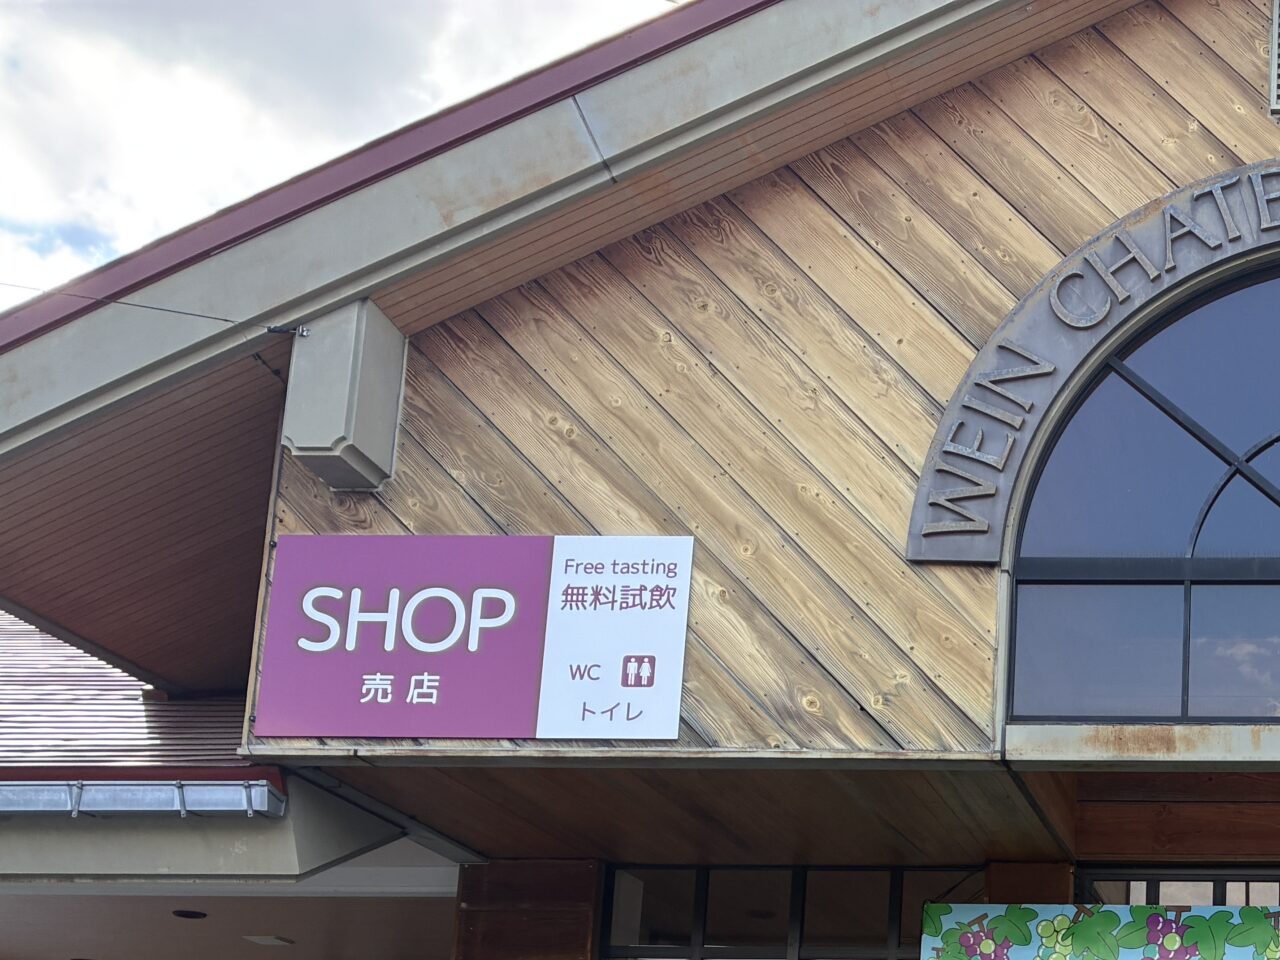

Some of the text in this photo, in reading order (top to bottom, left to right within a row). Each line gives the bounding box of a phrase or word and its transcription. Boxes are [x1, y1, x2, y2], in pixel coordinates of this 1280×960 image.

[922, 340, 1057, 538] WEIN
[564, 558, 679, 579] Free tasting
[561, 583, 677, 611] 無料試飲
[297, 586, 516, 653] SHOP
[569, 664, 601, 681] WC
[359, 672, 441, 704] 売店
[580, 701, 644, 722] トイレ
